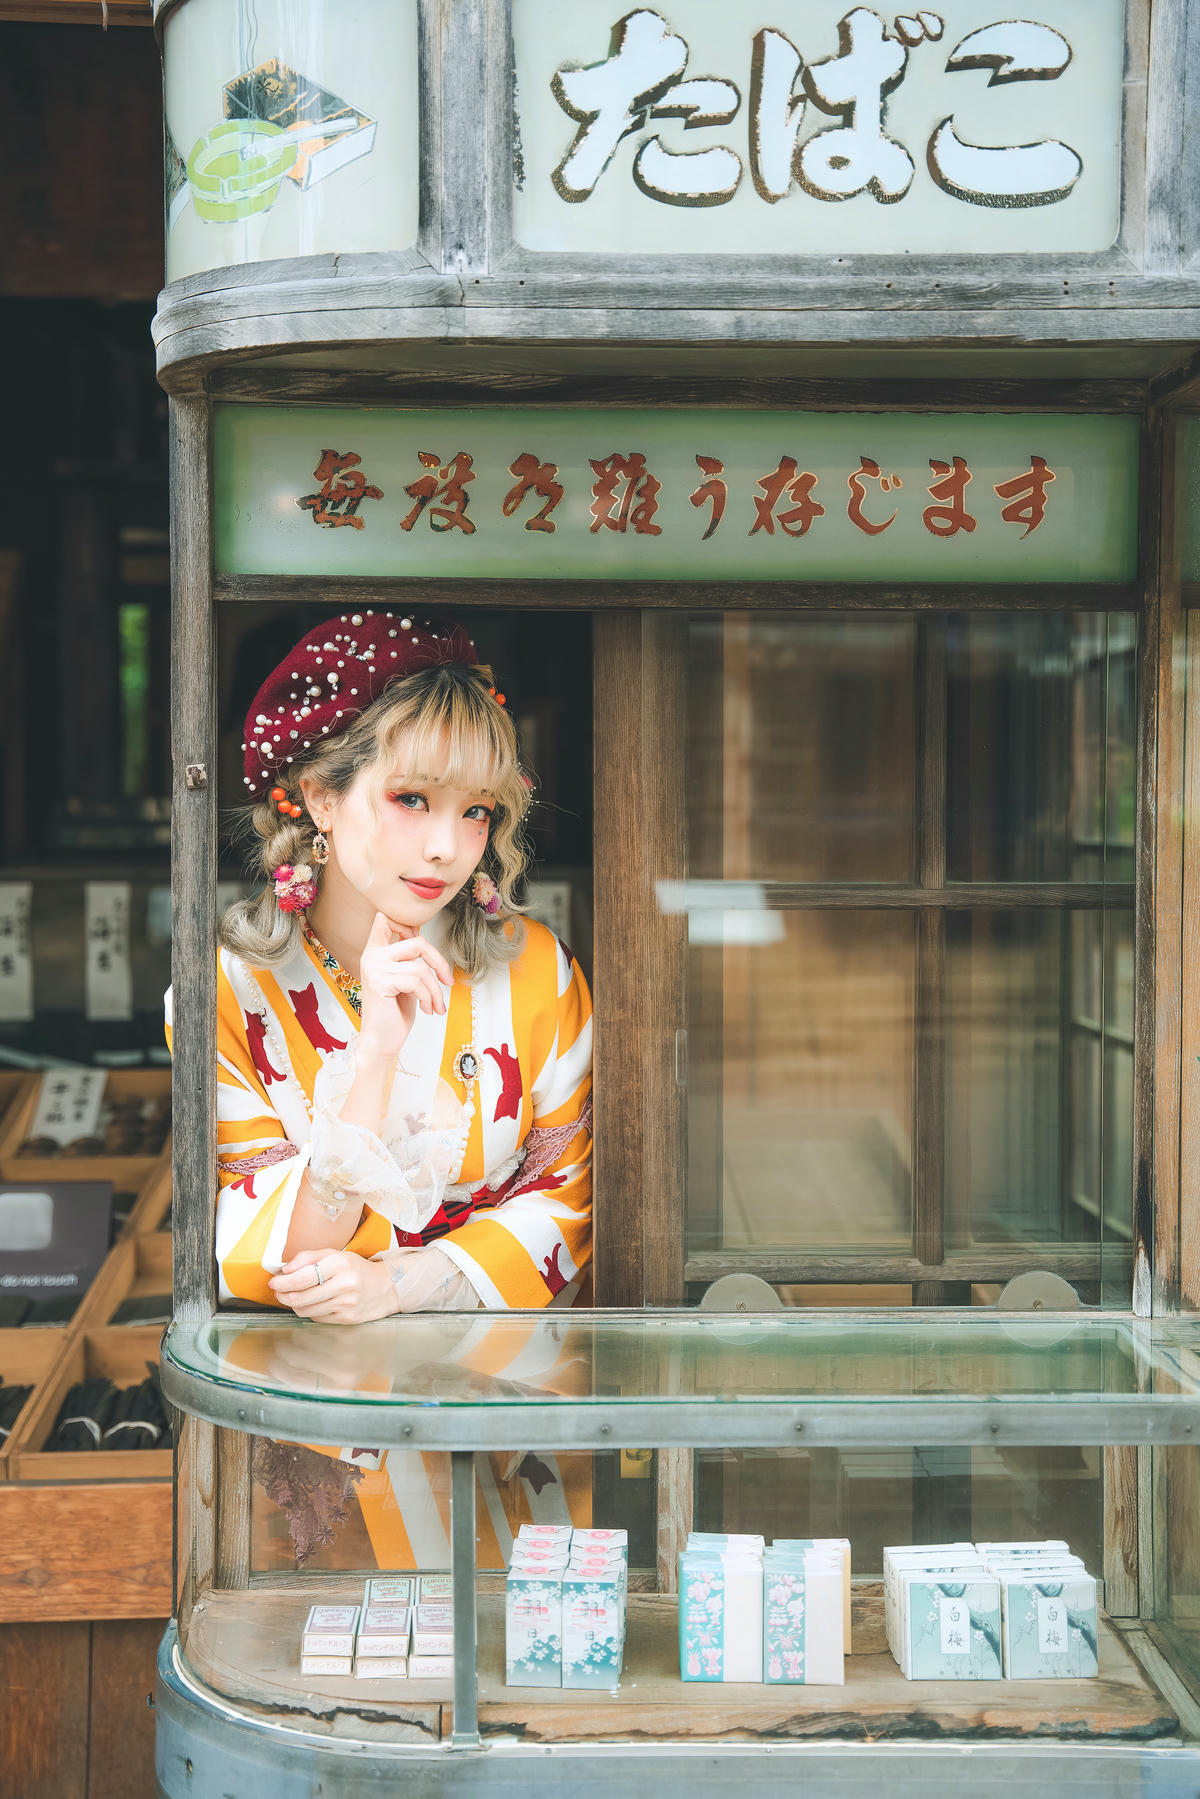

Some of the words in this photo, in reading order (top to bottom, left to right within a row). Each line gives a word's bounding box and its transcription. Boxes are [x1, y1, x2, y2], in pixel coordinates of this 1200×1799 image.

[550, 6, 1085, 209] たばこ
[21, 1275, 39, 1287] not
[42, 1274, 78, 1287] touch
[947, 1606, 965, 1648] 白梅
[1045, 1606, 1063, 1648] 白梅
